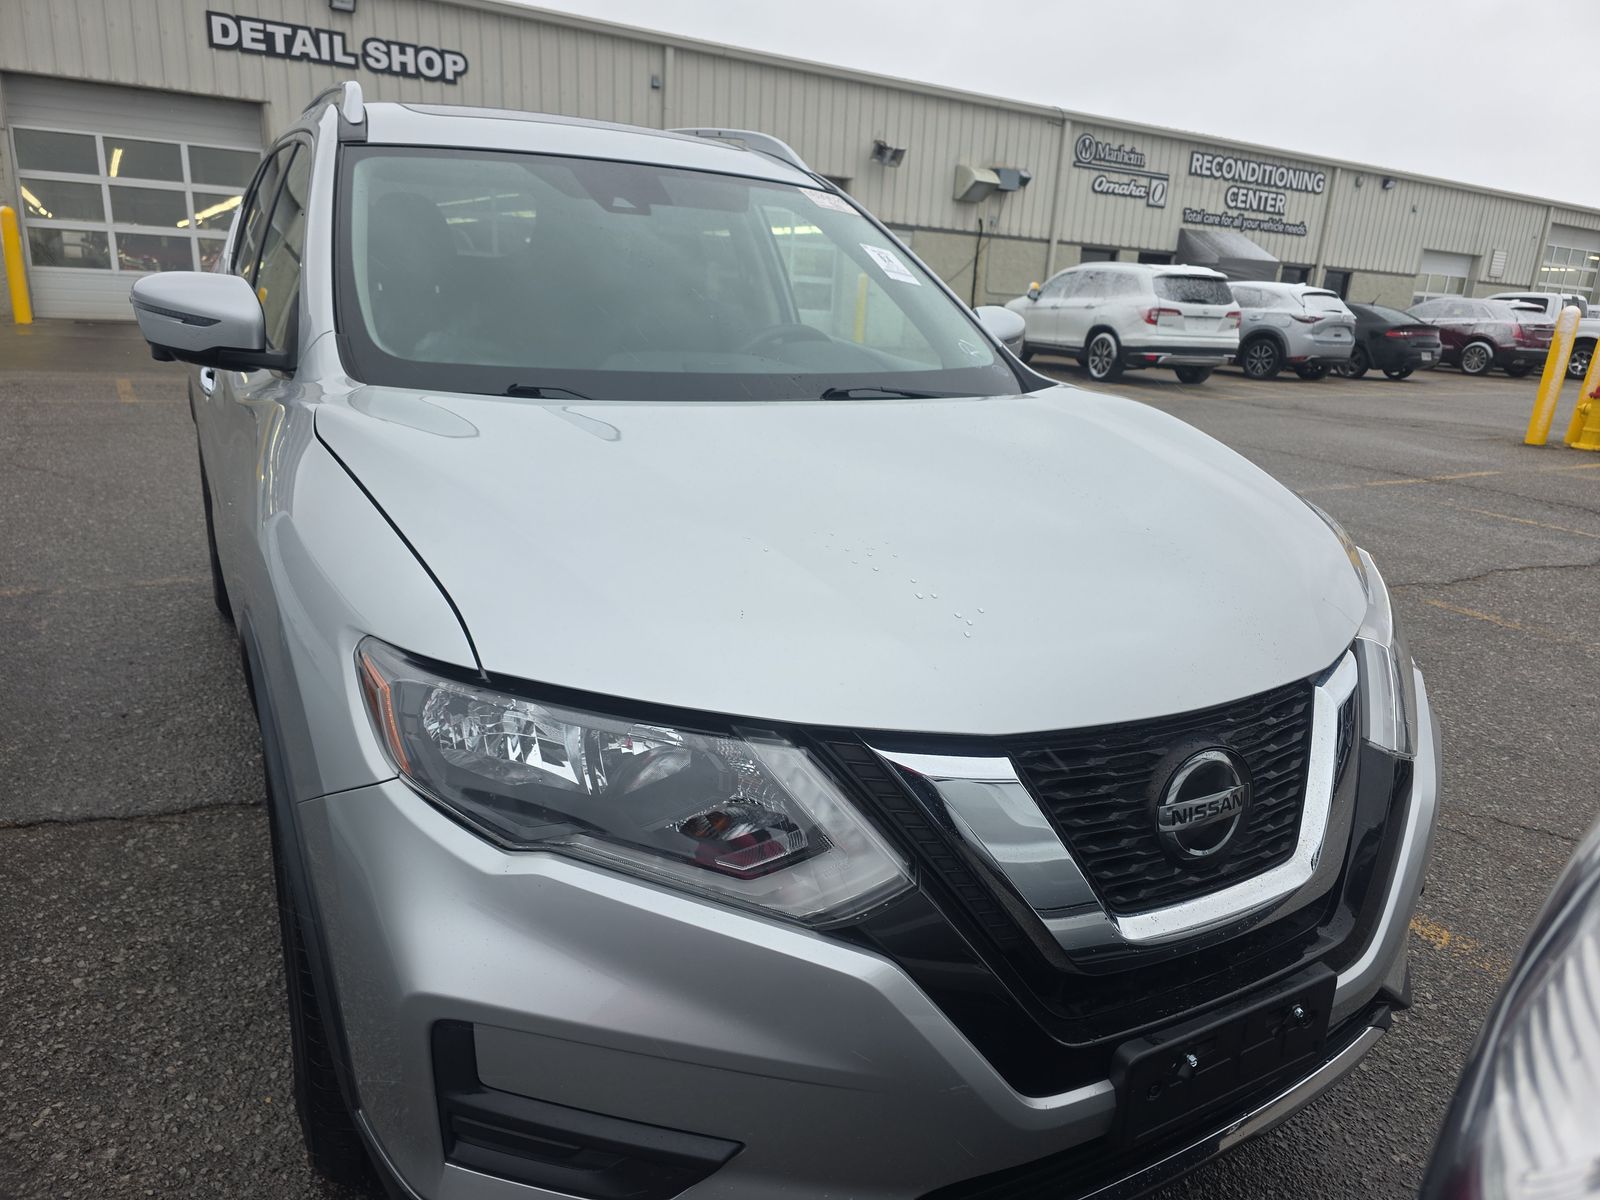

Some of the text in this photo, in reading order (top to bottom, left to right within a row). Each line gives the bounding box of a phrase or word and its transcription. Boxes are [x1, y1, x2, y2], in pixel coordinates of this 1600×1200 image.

[209, 13, 467, 82] DETAIL SHOP
[1096, 142, 1145, 167] Manheim
[1190, 152, 1325, 193] RECONDITIONING
[1093, 175, 1147, 198] Omaha
[1226, 187, 1286, 213] CENTER
[1184, 209, 1203, 222] Total
[1203, 214, 1220, 225] care
[1220, 213, 1232, 226] for
[1233, 214, 1243, 228] all
[1242, 220, 1260, 231] your
[1260, 219, 1284, 232] vehicle
[1171, 791, 1243, 826] NISSAN
